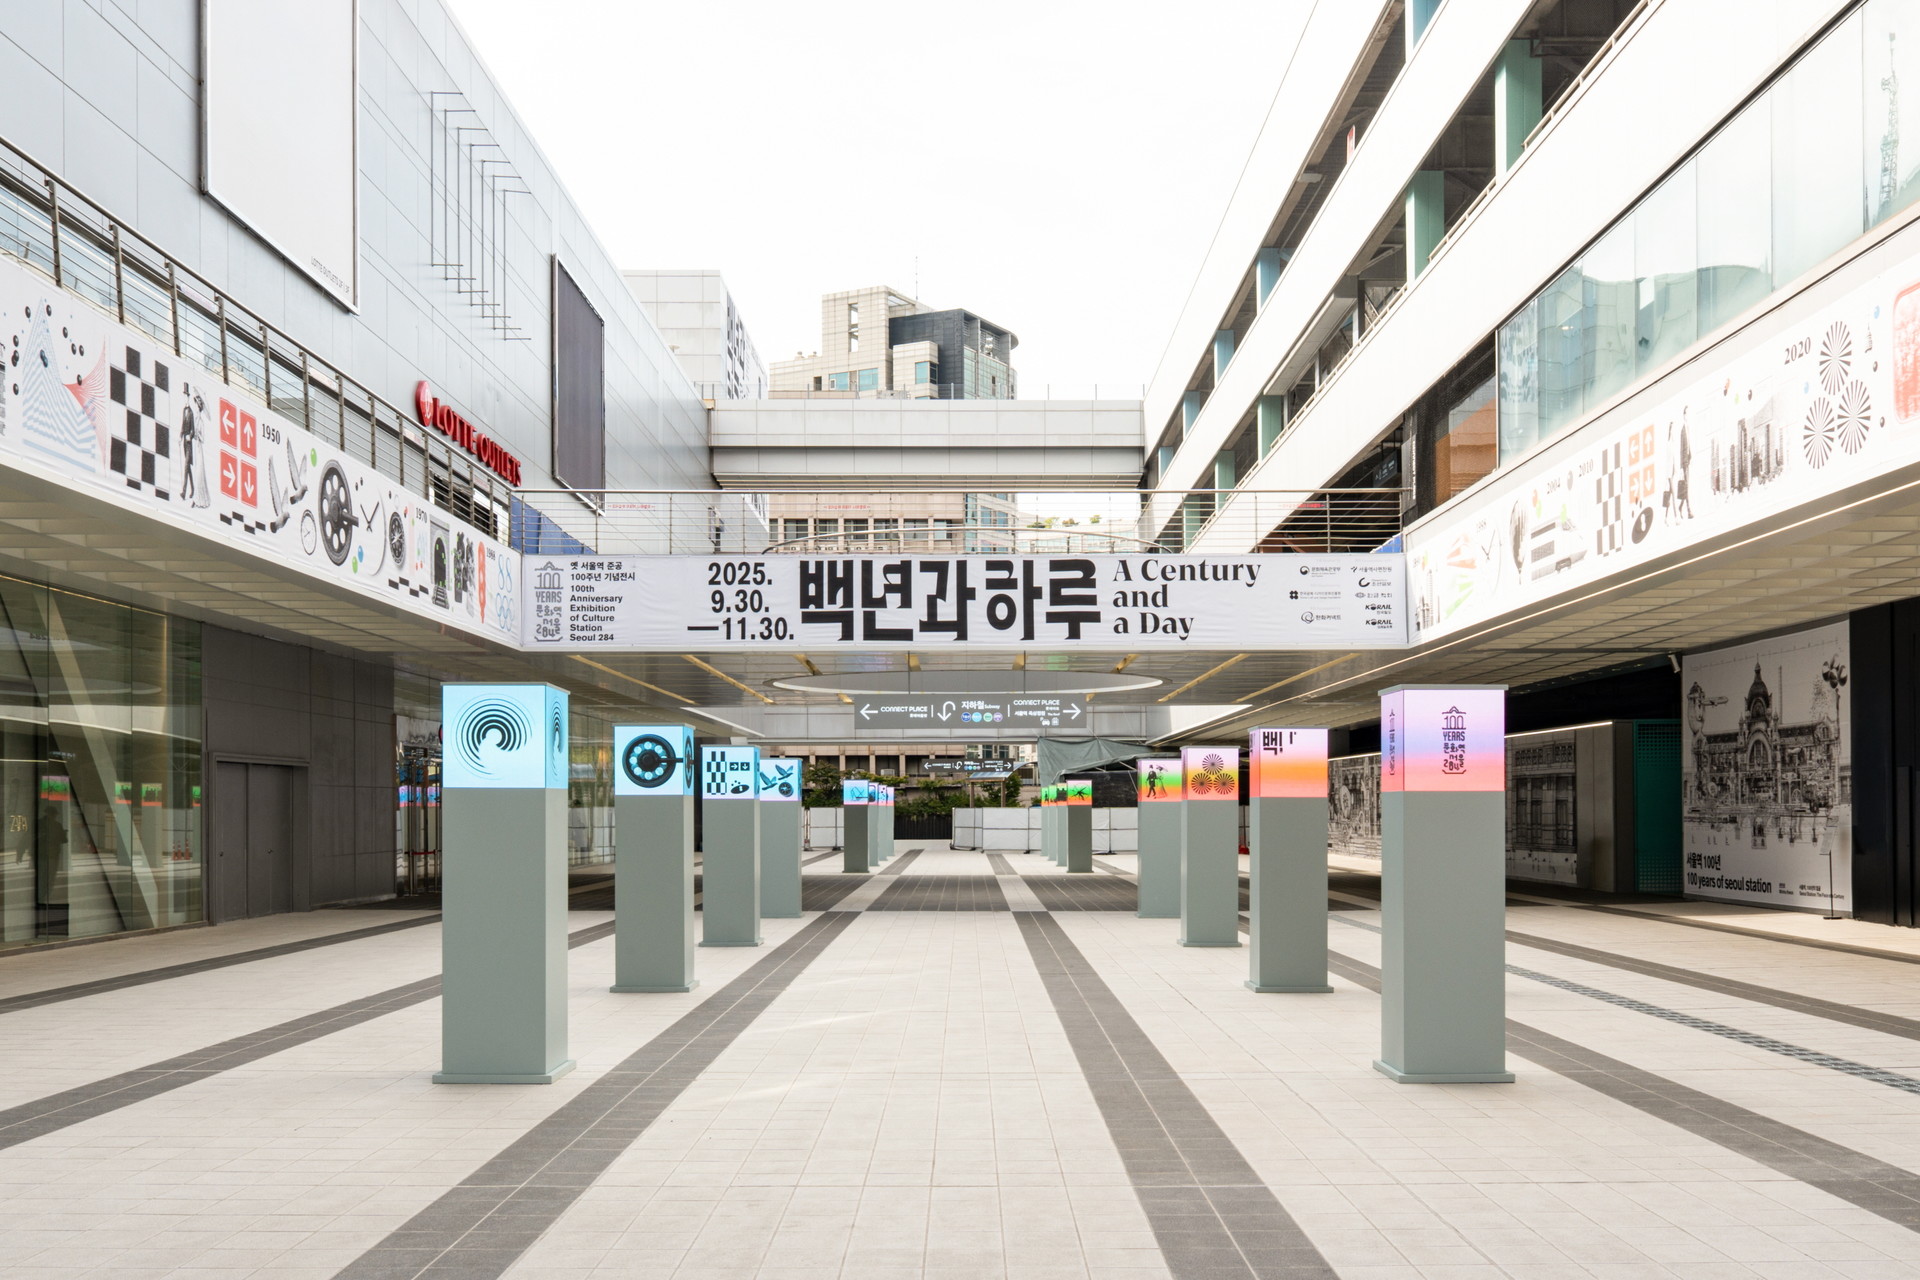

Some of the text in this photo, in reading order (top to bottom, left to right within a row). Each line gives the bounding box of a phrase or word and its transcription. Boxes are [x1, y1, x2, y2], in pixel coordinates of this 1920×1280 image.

[1784, 336, 1812, 365] 2020
[261, 422, 281, 445] 1950
[432, 397, 522, 487] LOTTE OUTLETS
[415, 507, 428, 524] 1970
[570, 561, 623, 571] 옛 서울역 준공
[571, 572, 636, 582] 100주년 기념전시
[708, 562, 773, 586] 2025.
[1113, 558, 1262, 588] A Century
[571, 584, 595, 593] 100th
[535, 590, 562, 603] YEARS
[570, 594, 623, 604] Anniversary
[711, 589, 770, 613] 9.30.
[1112, 583, 1169, 608] and
[570, 604, 616, 612] Exhibition
[1365, 603, 1392, 611] KORAIL
[570, 614, 615, 622] of Culture
[1365, 618, 1393, 626] KORAIL
[570, 624, 603, 632] Station
[1112, 611, 1195, 641] a Day
[570, 634, 596, 642] Seoul
[961, 700, 985, 710] 지하철
[1443, 714, 1465, 730] 100
[1442, 730, 1466, 742] YEARS
[1687, 852, 1721, 871] 서울역 100년
[1687, 872, 1698, 886] 100
[1698, 874, 1716, 889] years
[1716, 874, 1724, 889] of
[1724, 876, 1745, 891] seoul
[1745, 877, 1772, 893] station
